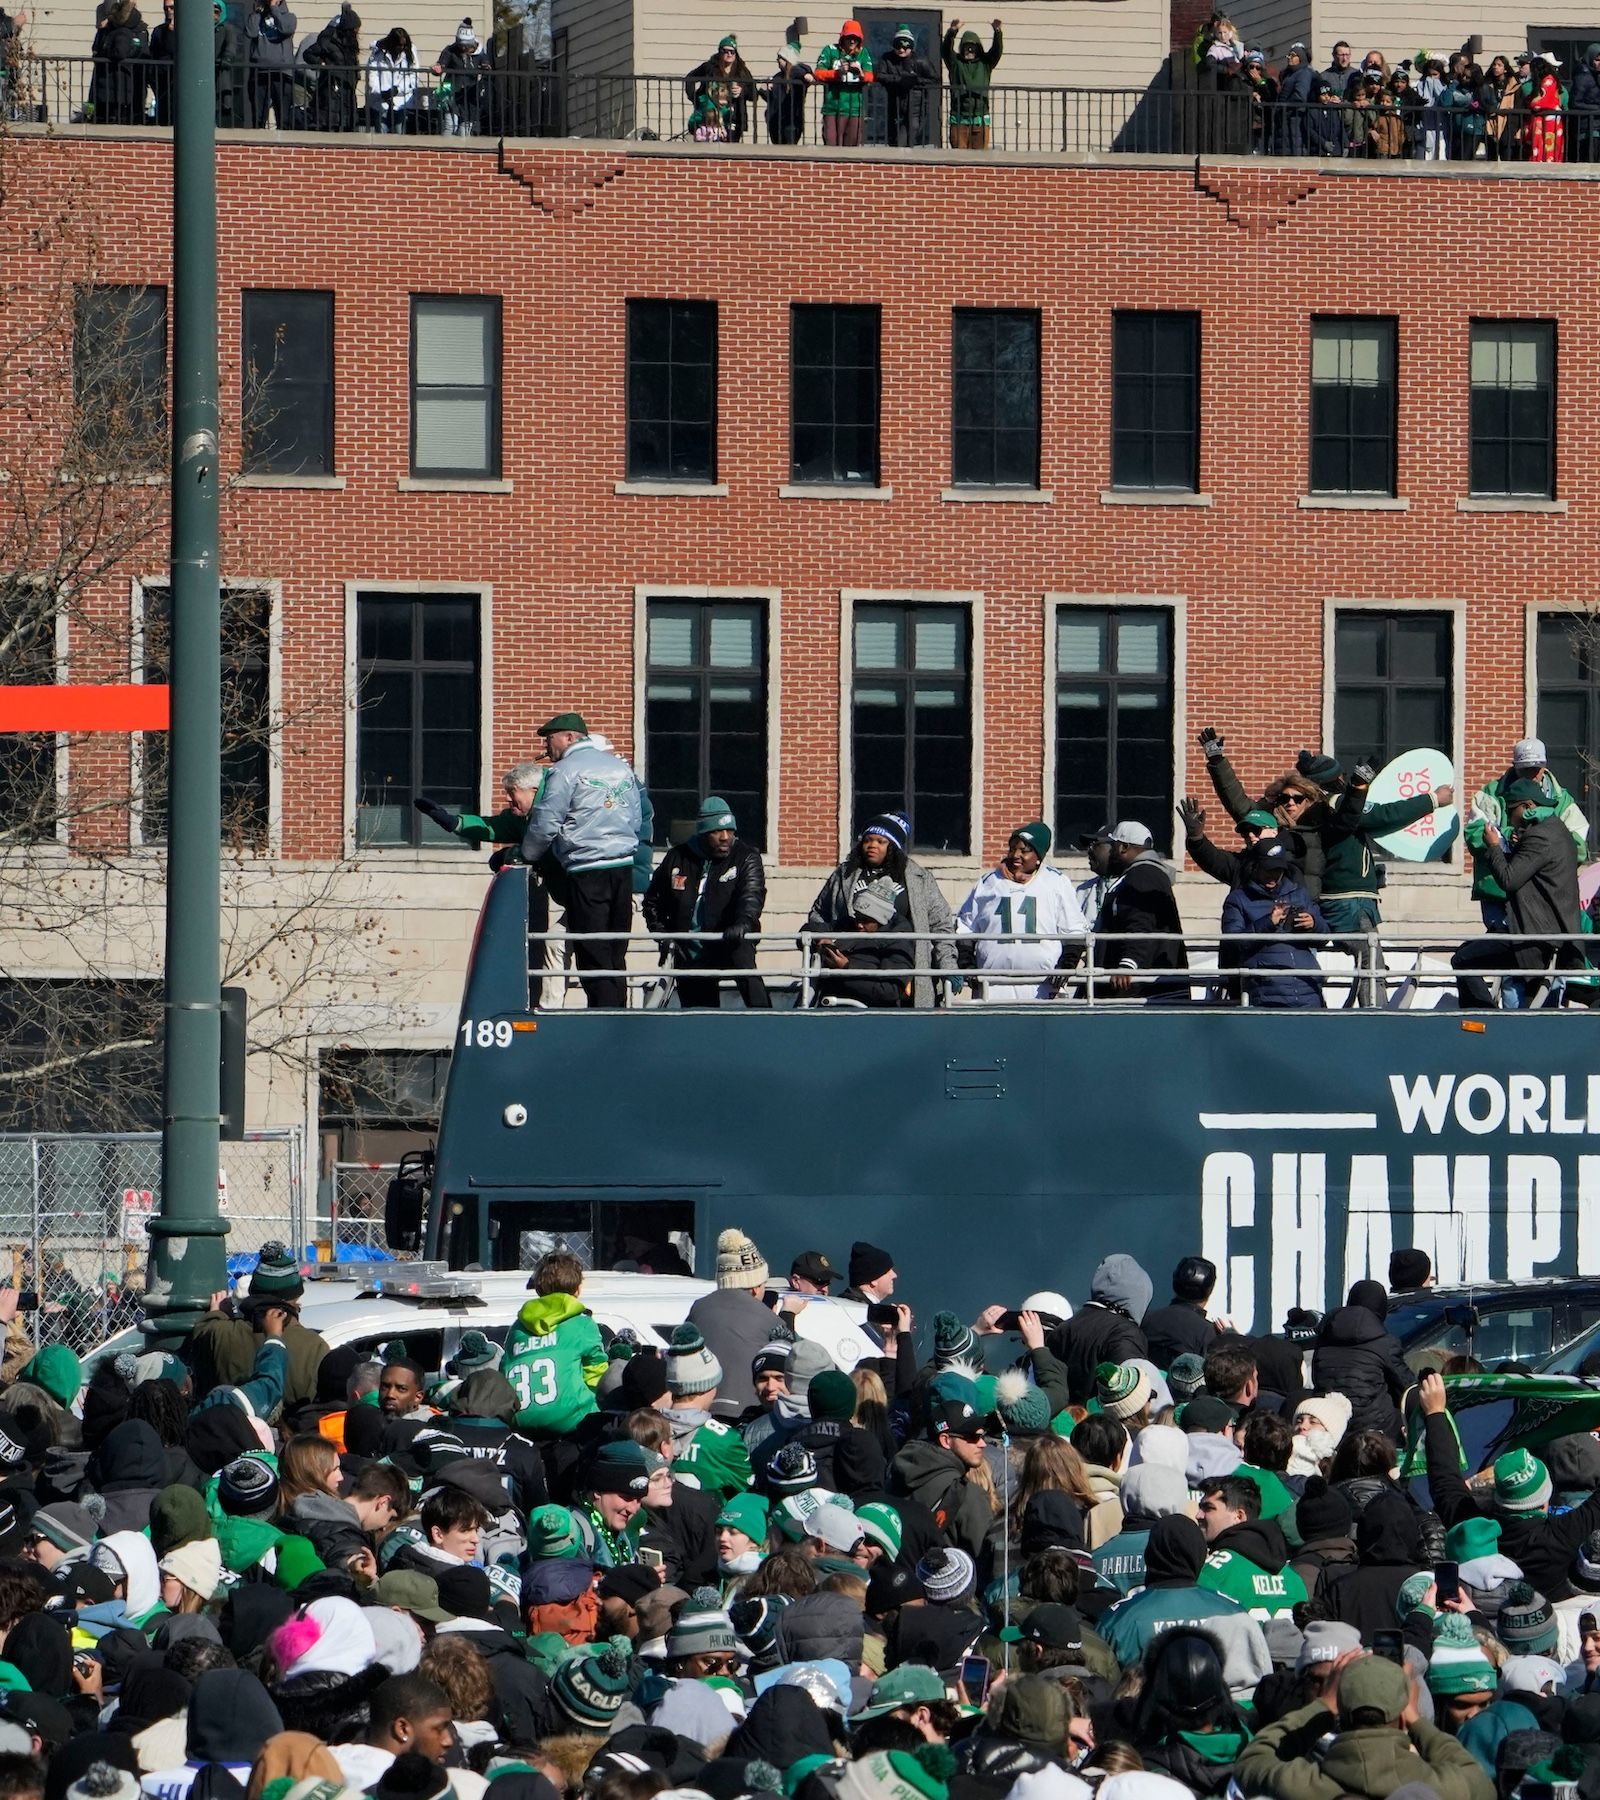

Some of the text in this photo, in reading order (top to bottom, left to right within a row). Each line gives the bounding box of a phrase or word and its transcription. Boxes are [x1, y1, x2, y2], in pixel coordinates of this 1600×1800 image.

[994, 896, 1041, 944] 11
[461, 1018, 515, 1050] 189
[1101, 1554, 1148, 1576] BARKLE
[1251, 1574, 1287, 1596] KELCE
